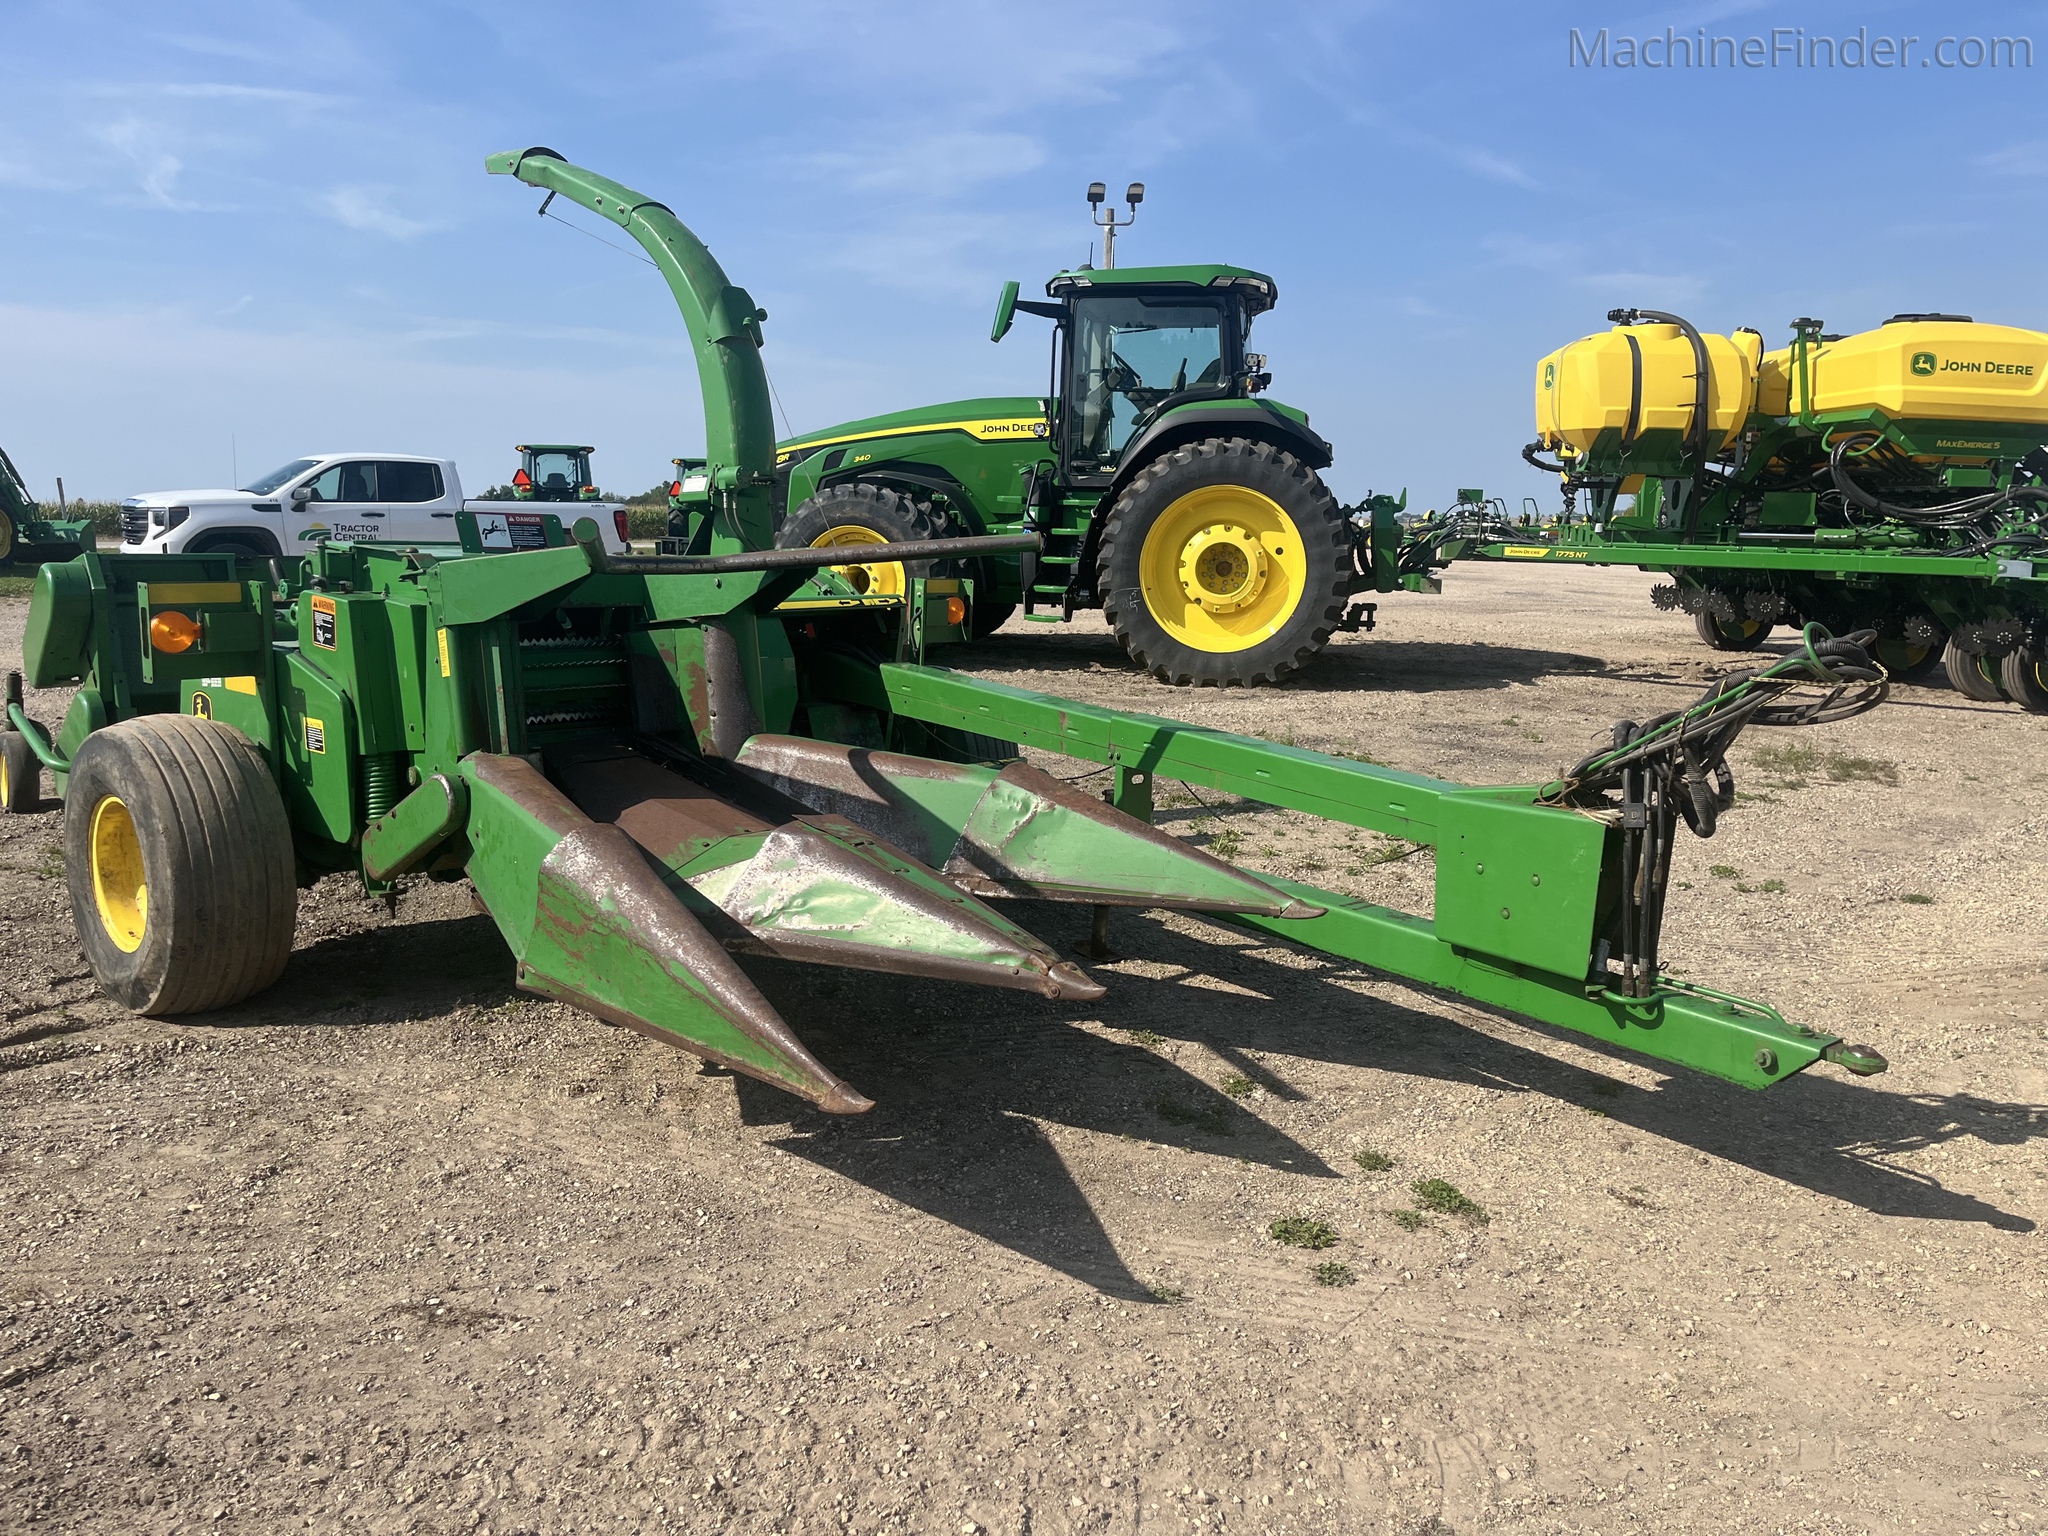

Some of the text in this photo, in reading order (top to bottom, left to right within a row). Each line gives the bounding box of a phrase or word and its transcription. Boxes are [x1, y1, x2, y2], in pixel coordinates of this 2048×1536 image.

[1993, 441, 2001, 450] 5
[776, 453, 790, 464] 8R
[853, 454, 871, 463] 340
[1555, 550, 1575, 558] 1775
